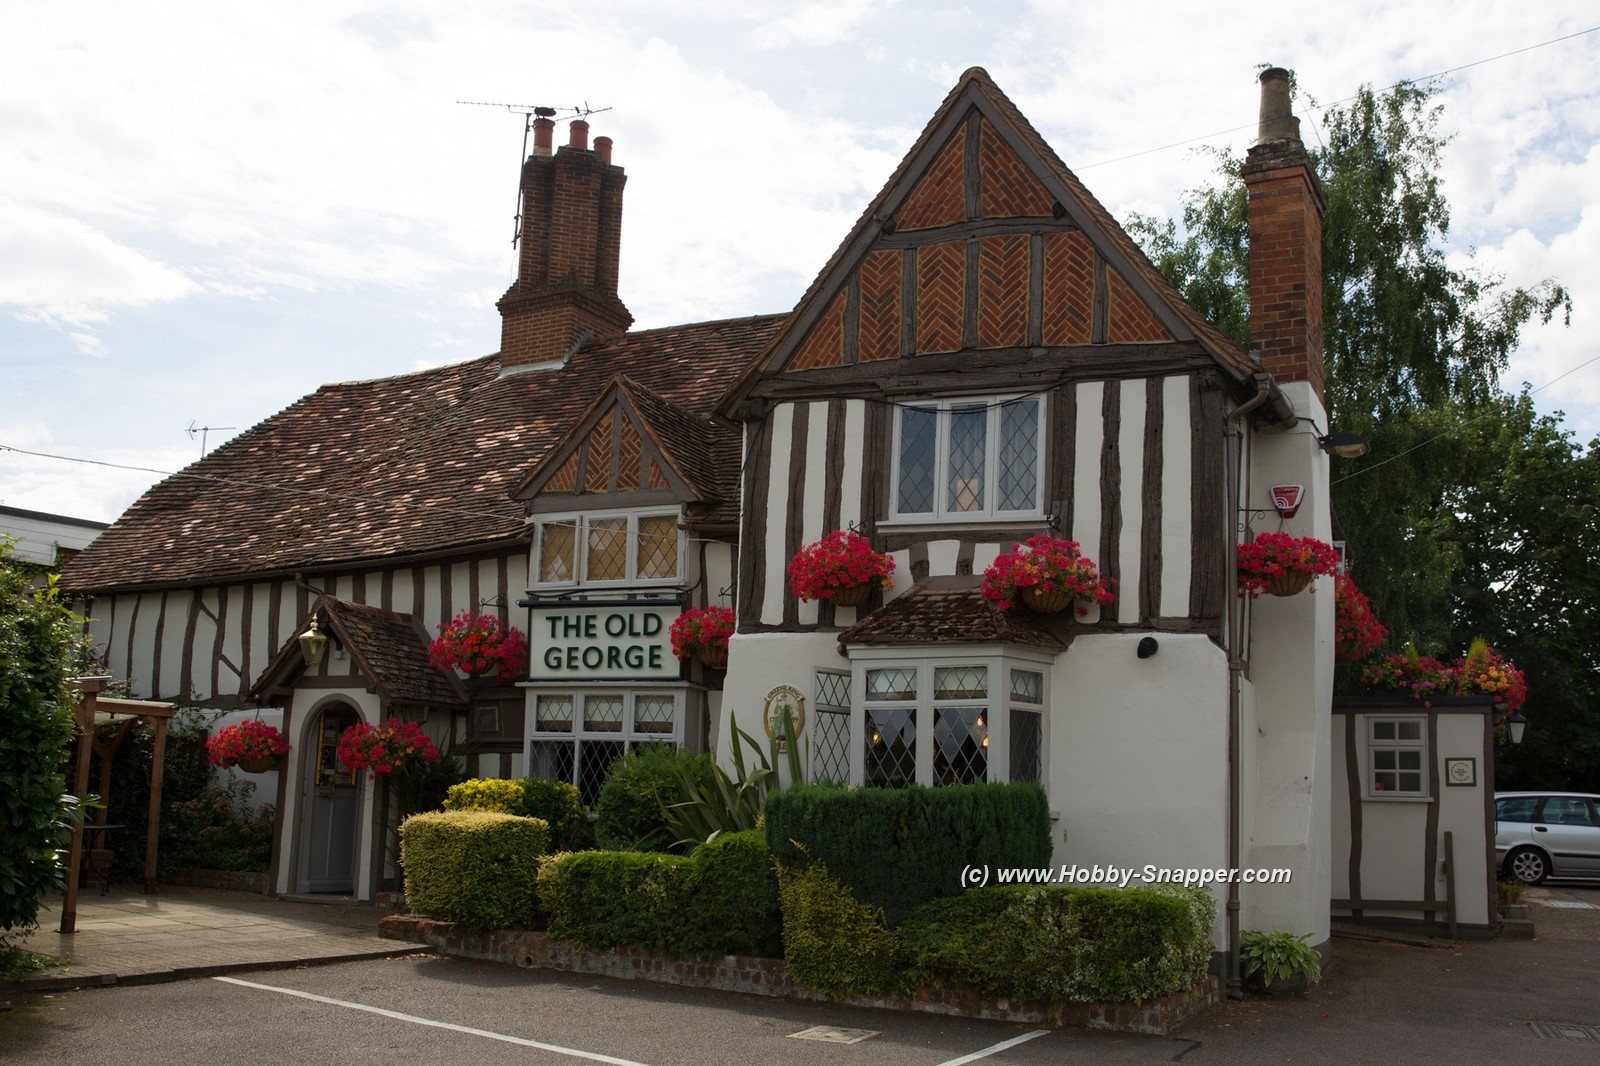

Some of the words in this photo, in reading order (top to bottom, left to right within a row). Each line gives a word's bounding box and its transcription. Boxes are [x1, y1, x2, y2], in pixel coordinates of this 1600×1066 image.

[546, 615, 597, 638] THE
[605, 613, 662, 637] OLD
[544, 645, 662, 669] GEORGE
[767, 685, 787, 698] GREENE
[789, 686, 801, 698] KING
